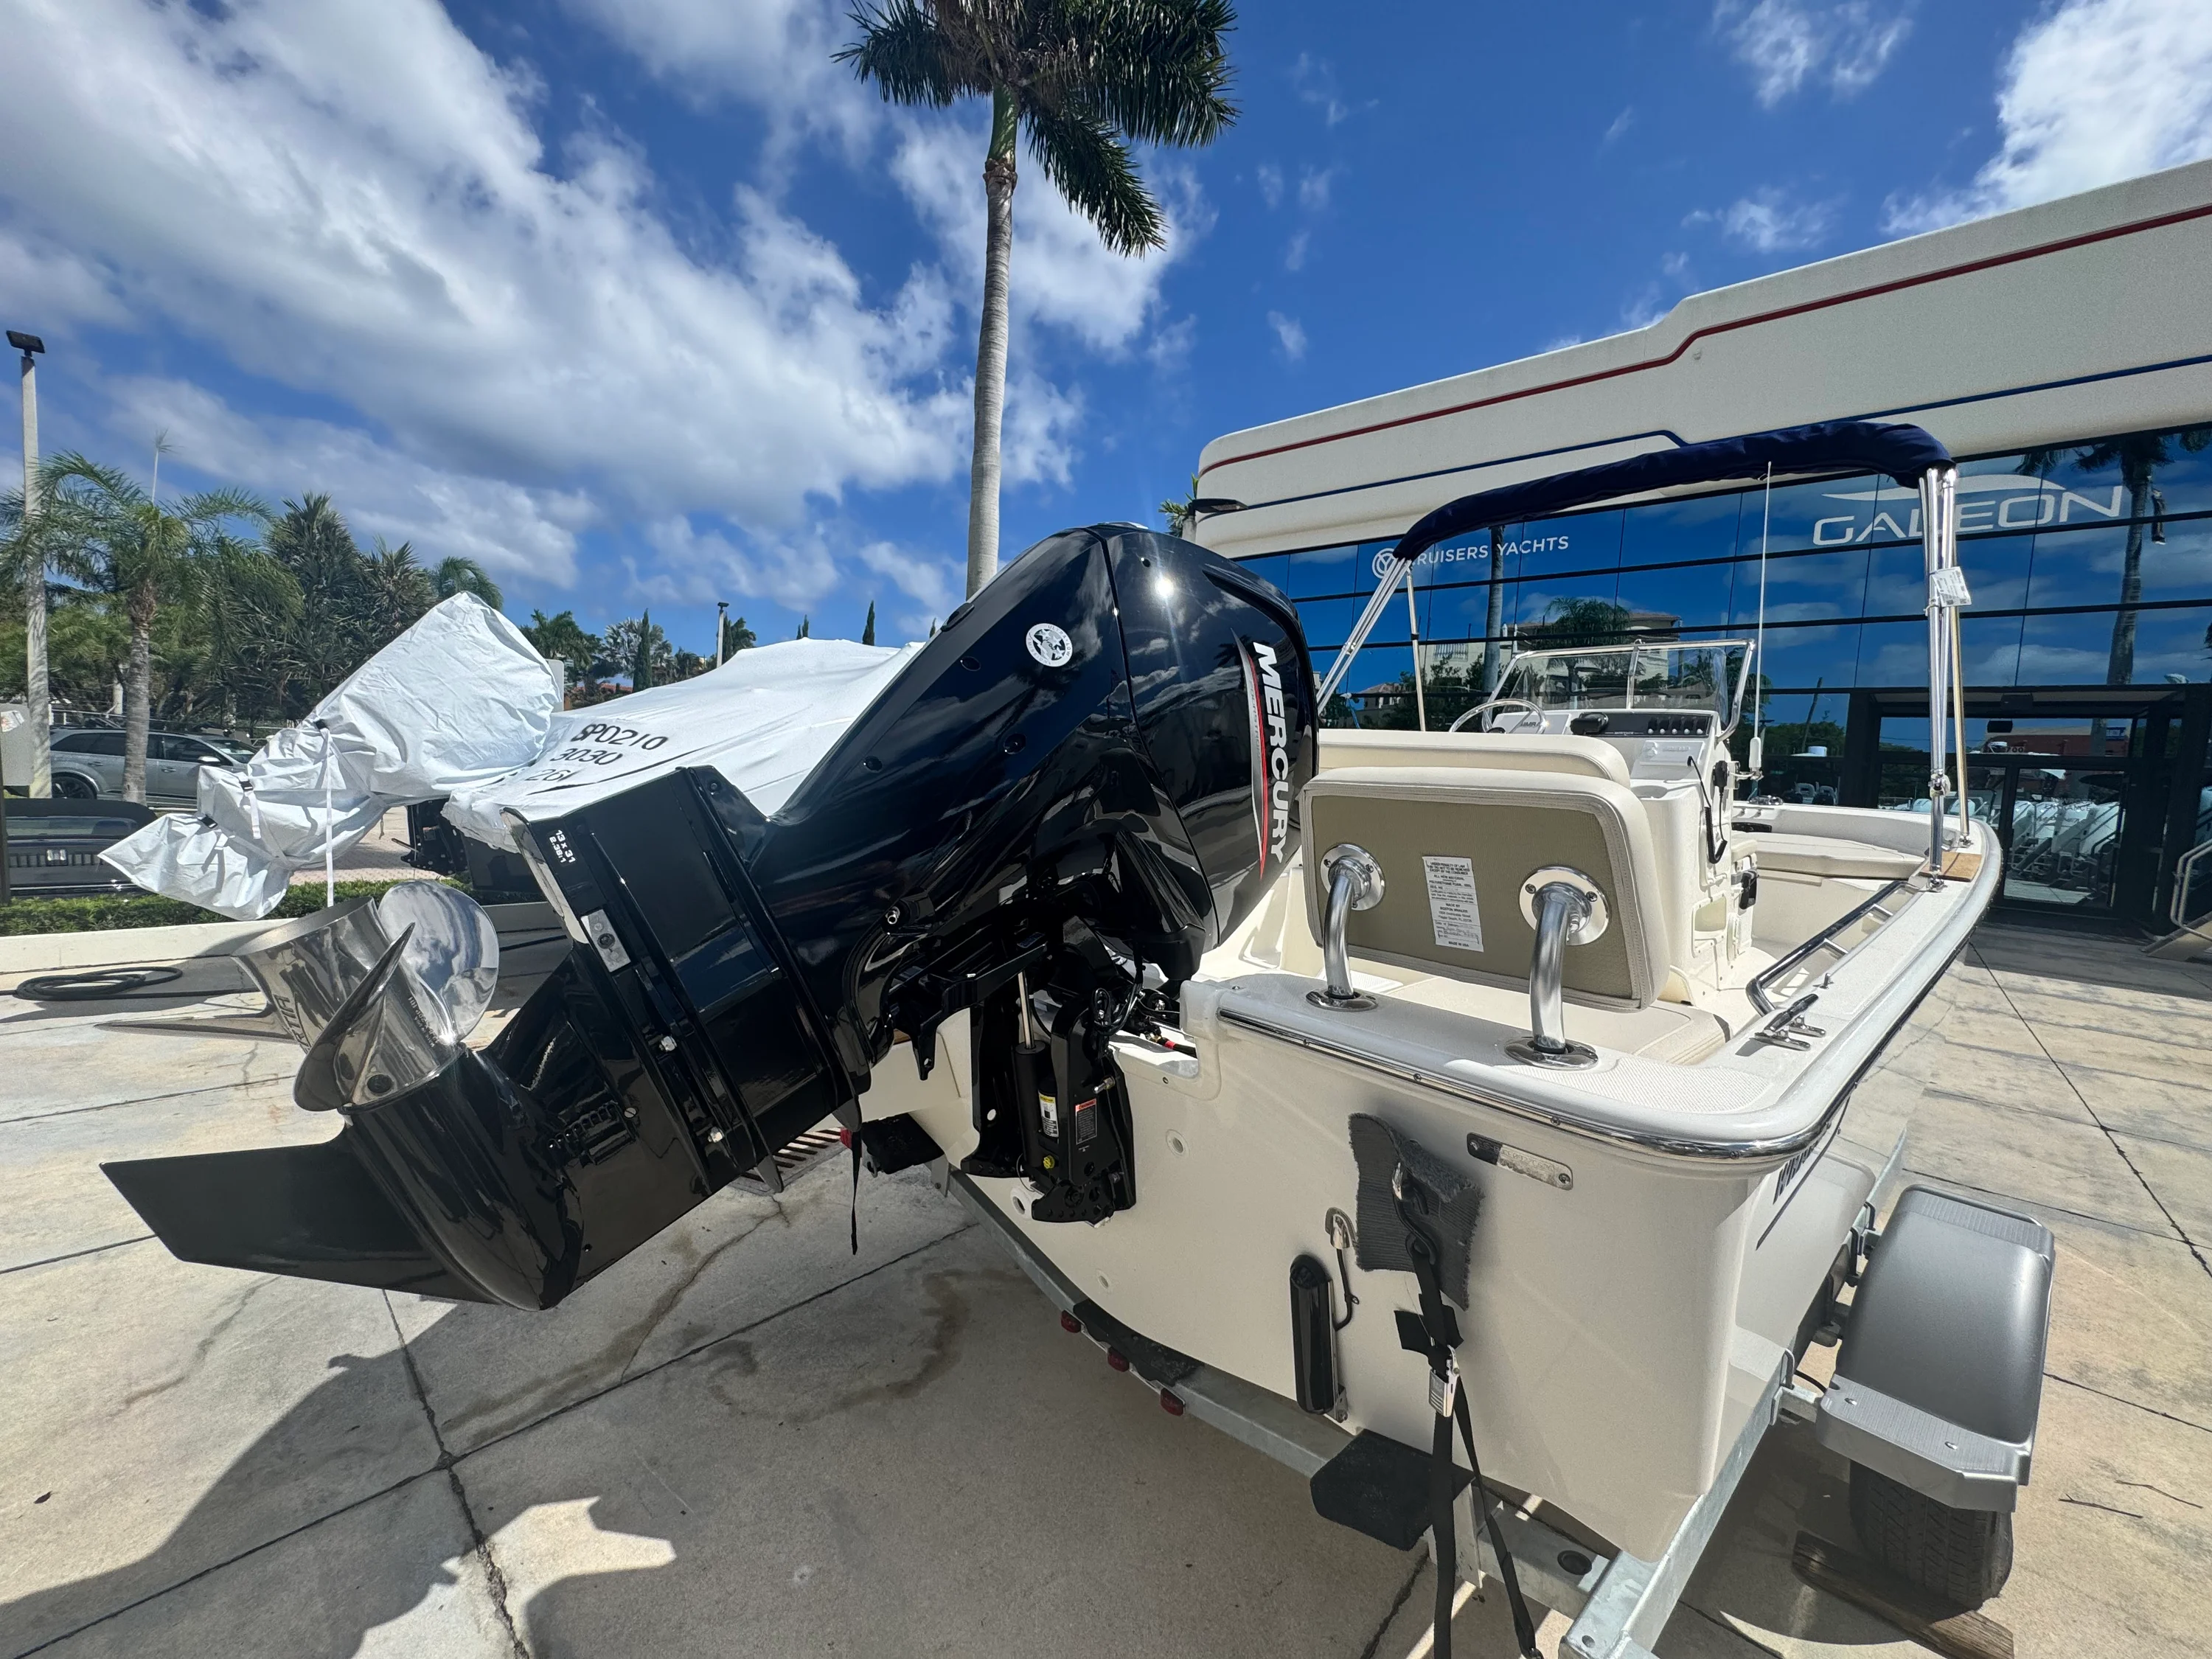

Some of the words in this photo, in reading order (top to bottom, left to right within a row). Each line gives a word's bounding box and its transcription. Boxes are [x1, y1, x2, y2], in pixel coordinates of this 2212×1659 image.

[1812, 485, 2122, 546] GALEON
[1411, 545, 1489, 566] RUISERS
[1496, 535, 1569, 556] YACHTS
[550, 748, 623, 765] 3030
[1253, 641, 1289, 863] MERCURY
[555, 830, 566, 842] 13
[564, 849, 576, 863] 31
